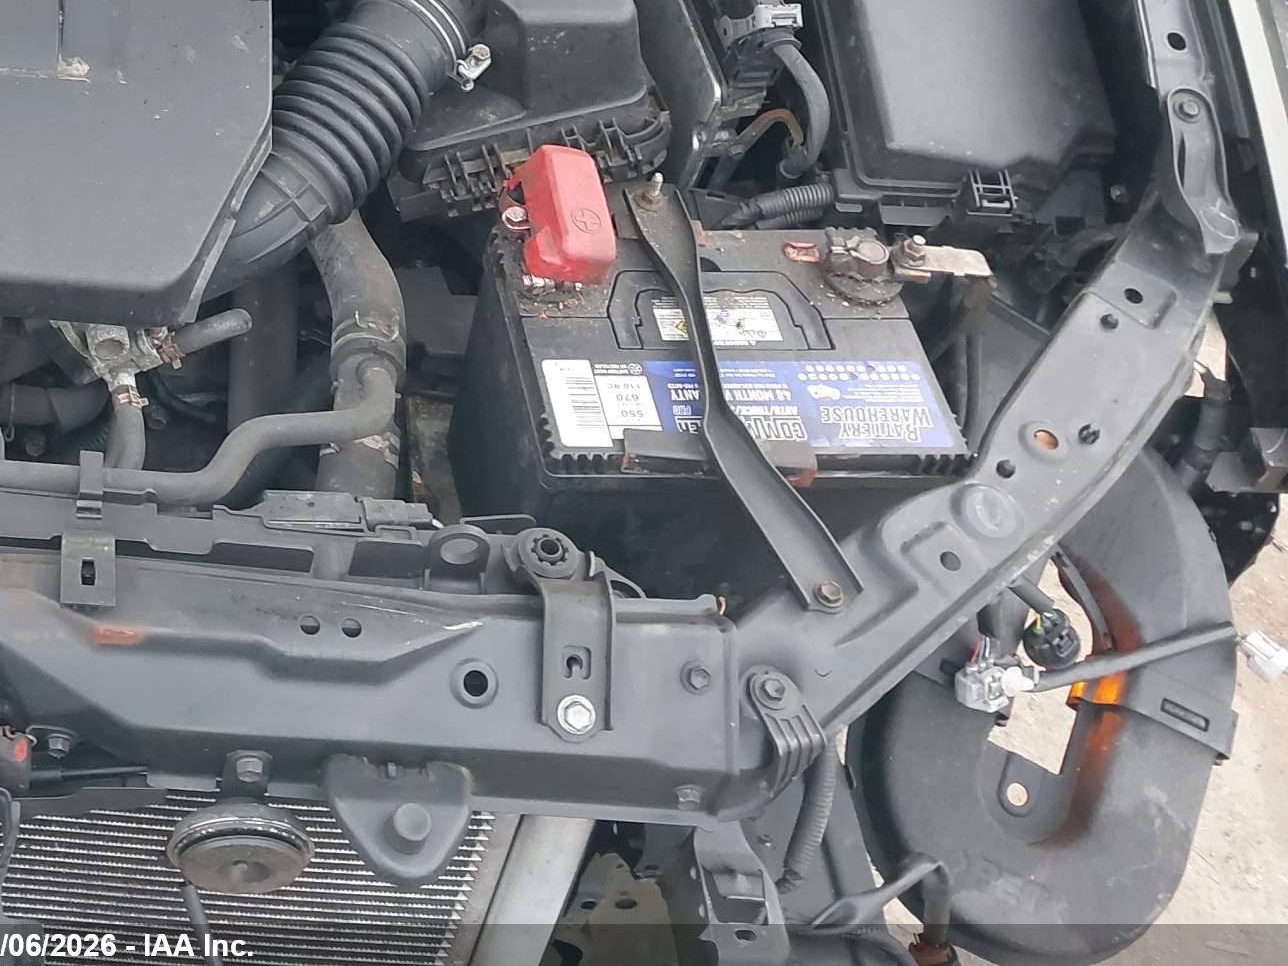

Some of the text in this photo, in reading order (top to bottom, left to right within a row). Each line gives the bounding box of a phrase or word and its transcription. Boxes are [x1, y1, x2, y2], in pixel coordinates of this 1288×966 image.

[616, 393, 640, 402] 670
[734, 389, 774, 402] MONTH
[776, 388, 792, 402] 48
[621, 410, 645, 418] 550
[672, 404, 692, 416] PRO
[820, 406, 934, 428] WAREHOUSE
[839, 423, 921, 443] BATTERY
